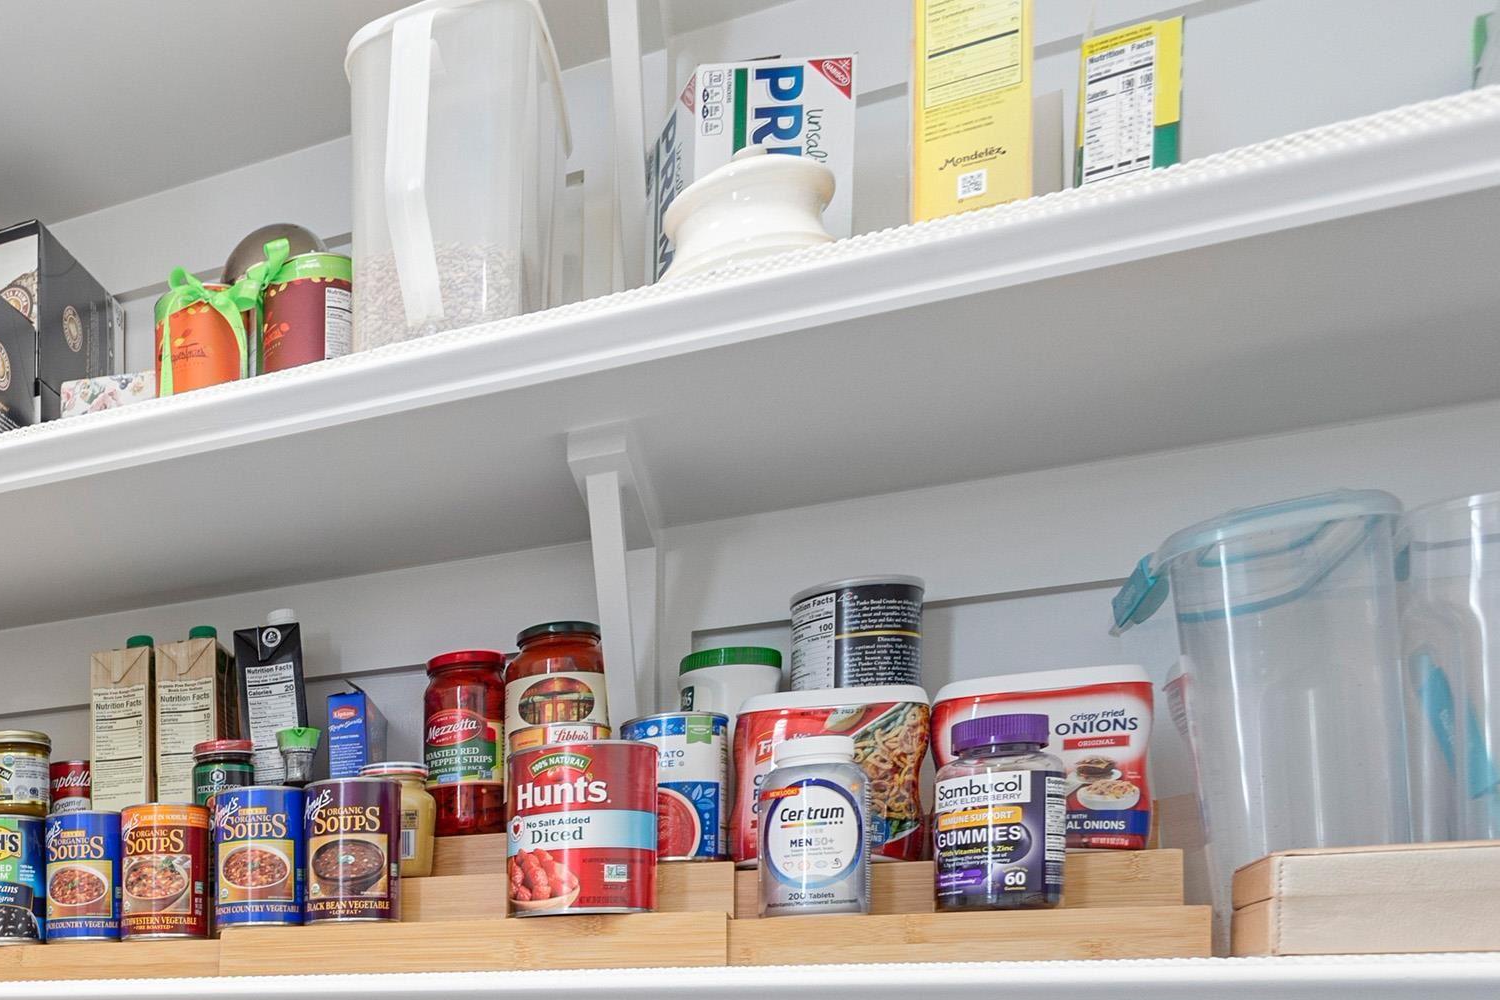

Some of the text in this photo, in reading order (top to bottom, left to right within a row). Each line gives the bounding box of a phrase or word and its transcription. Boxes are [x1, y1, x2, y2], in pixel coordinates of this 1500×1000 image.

[1088, 38, 1154, 64] Nutrition Facts
[823, 60, 849, 86] NABISCO
[805, 108, 828, 163] unsal
[812, 595, 834, 607] Facts
[818, 623, 834, 632] 100
[247, 663, 293, 676] Nutrition Facts
[248, 690, 272, 698] Calories
[284, 683, 295, 693] 20
[160, 691, 210, 704] Nutrition Facts
[95, 698, 142, 711] Nutrition Facts
[135, 718, 143, 726] 10
[203, 712, 211, 721] 10
[1069, 708, 1126, 724] Crispy Fried
[426, 718, 479, 743] Mezzetta
[1055, 716, 1139, 736] ONIONS
[1077, 738, 1116, 749] ORIGINAL
[459, 746, 480, 756] RED
[429, 754, 494, 769] PEPPER STRIPS
[533, 755, 586, 773] 100% NATURAL
[467, 764, 483, 772] PACK
[938, 774, 1023, 802] Sambucol
[55, 799, 76, 811] Cream
[304, 788, 334, 830] Amy's
[938, 799, 959, 810] BLACK
[327, 806, 364, 817] ORGANIC
[233, 815, 271, 826] ORGANIC
[313, 806, 381, 835] SOUPS
[526, 815, 592, 830] No Salt Added
[942, 810, 1014, 826] IMMUNE SUPPORT
[222, 813, 287, 841] SOUPS
[1083, 819, 1127, 834] ONIONS
[135, 829, 168, 839] ORGANIC
[531, 825, 584, 845] Diced
[55, 836, 90, 847] ORGANIC
[125, 828, 185, 856] SOUPS
[789, 838, 835, 849] MEN 50+
[49, 835, 105, 862] SOUPS
[955, 845, 1015, 857] Vitamin Zinc
[1004, 871, 1027, 886] 60
[787, 892, 835, 901] 200 Tablets
[232, 903, 265, 914] COUNTRY
[306, 900, 390, 912] BLACK BEAN VEGETABLE
[55, 919, 119, 931] COUNTRY VEGETABLE
[160, 916, 198, 926] VEGETABLE
